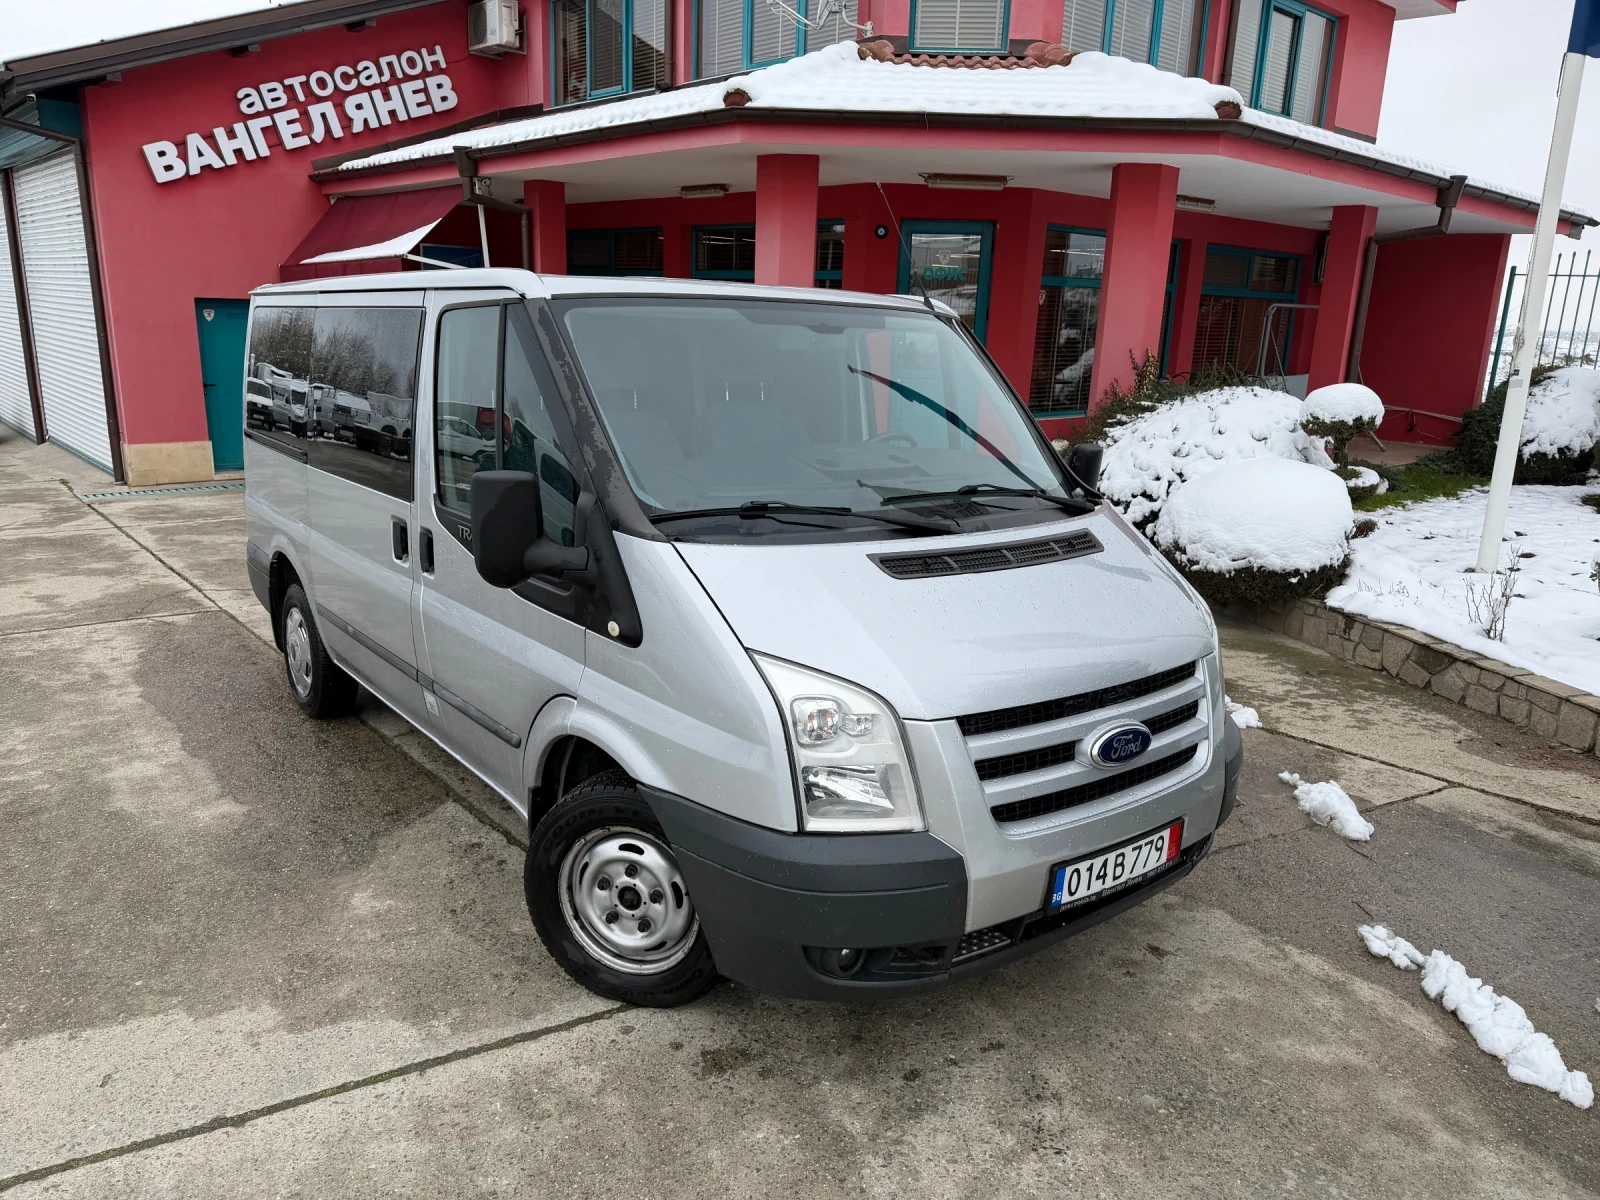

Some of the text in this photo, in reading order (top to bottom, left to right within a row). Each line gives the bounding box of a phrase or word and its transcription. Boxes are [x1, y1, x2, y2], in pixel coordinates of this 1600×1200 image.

[236, 45, 447, 115] автосалон
[141, 74, 459, 184] ВАНГЕЛ ЯНЕВ
[923, 267, 967, 281] ОФИС
[457, 524, 473, 541] TR
[1111, 733, 1143, 760] Ford
